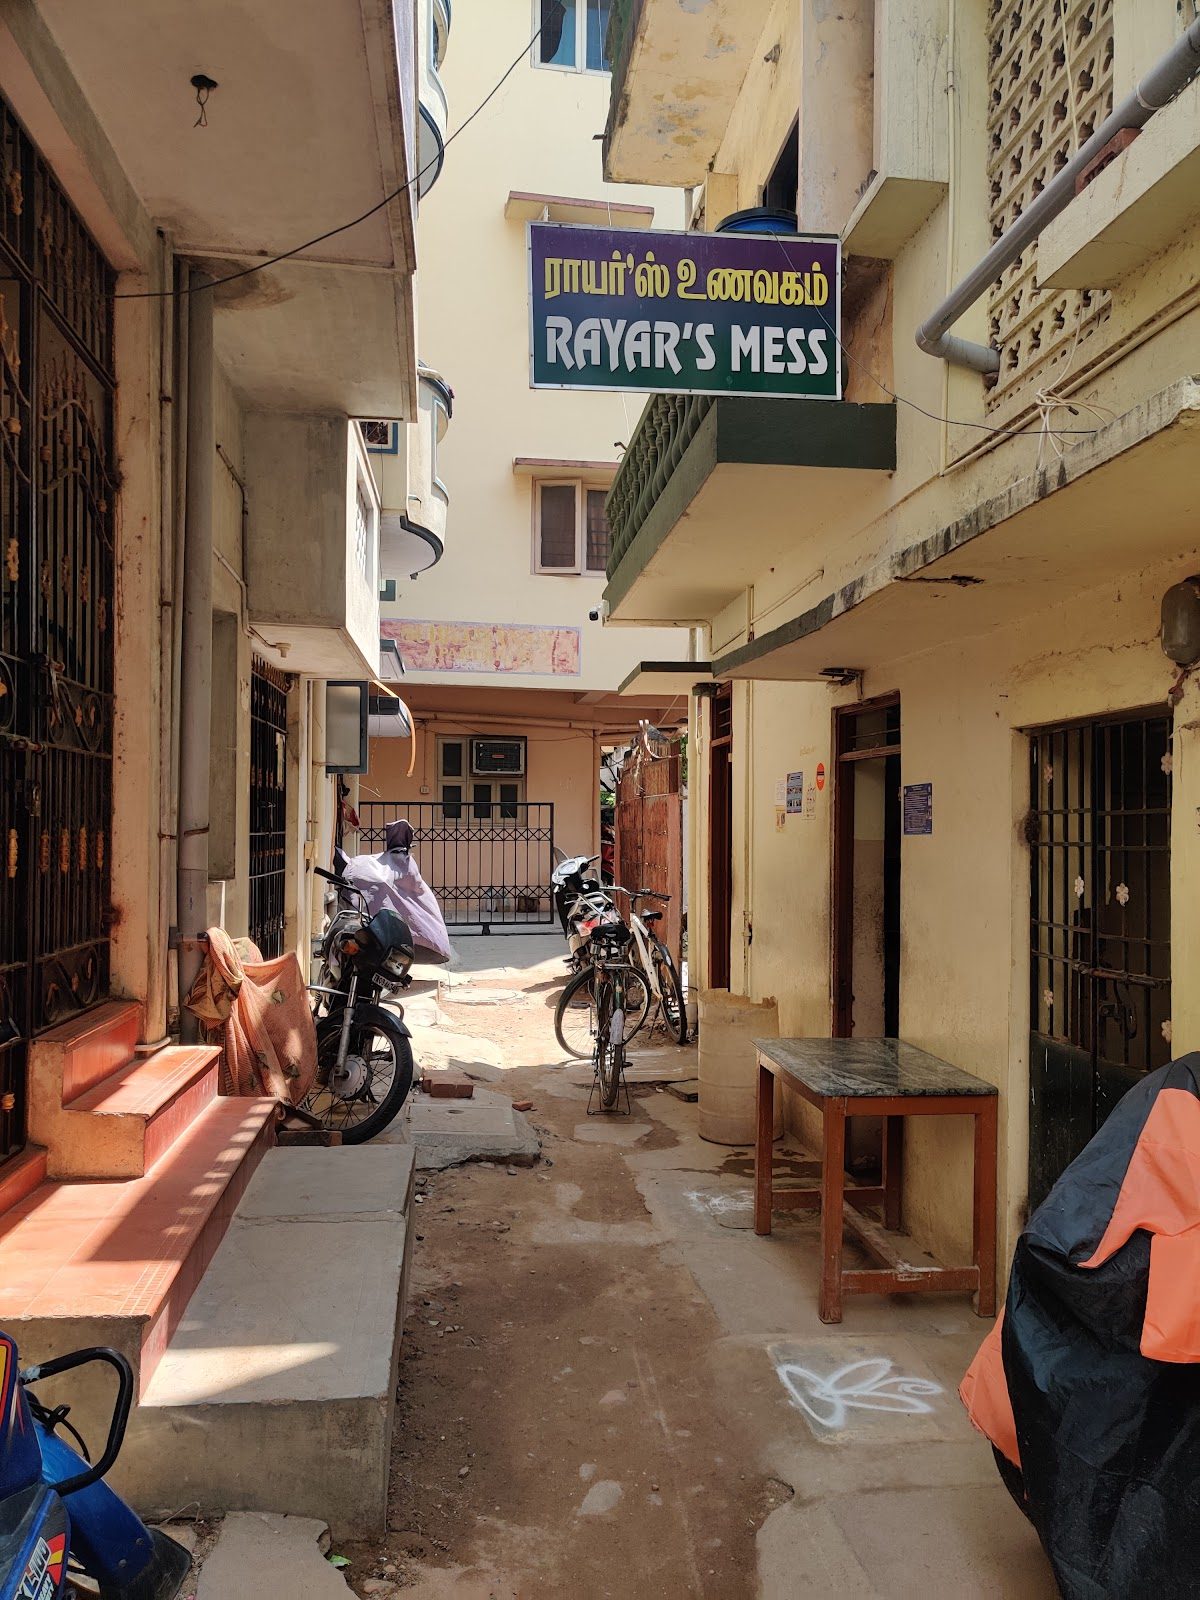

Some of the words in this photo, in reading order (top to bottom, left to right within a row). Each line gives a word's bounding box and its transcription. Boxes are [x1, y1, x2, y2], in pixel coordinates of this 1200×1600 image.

[677, 258, 829, 307] உணவகம்
[545, 316, 716, 375] RAYAR'S
[731, 325, 828, 375] MESS
